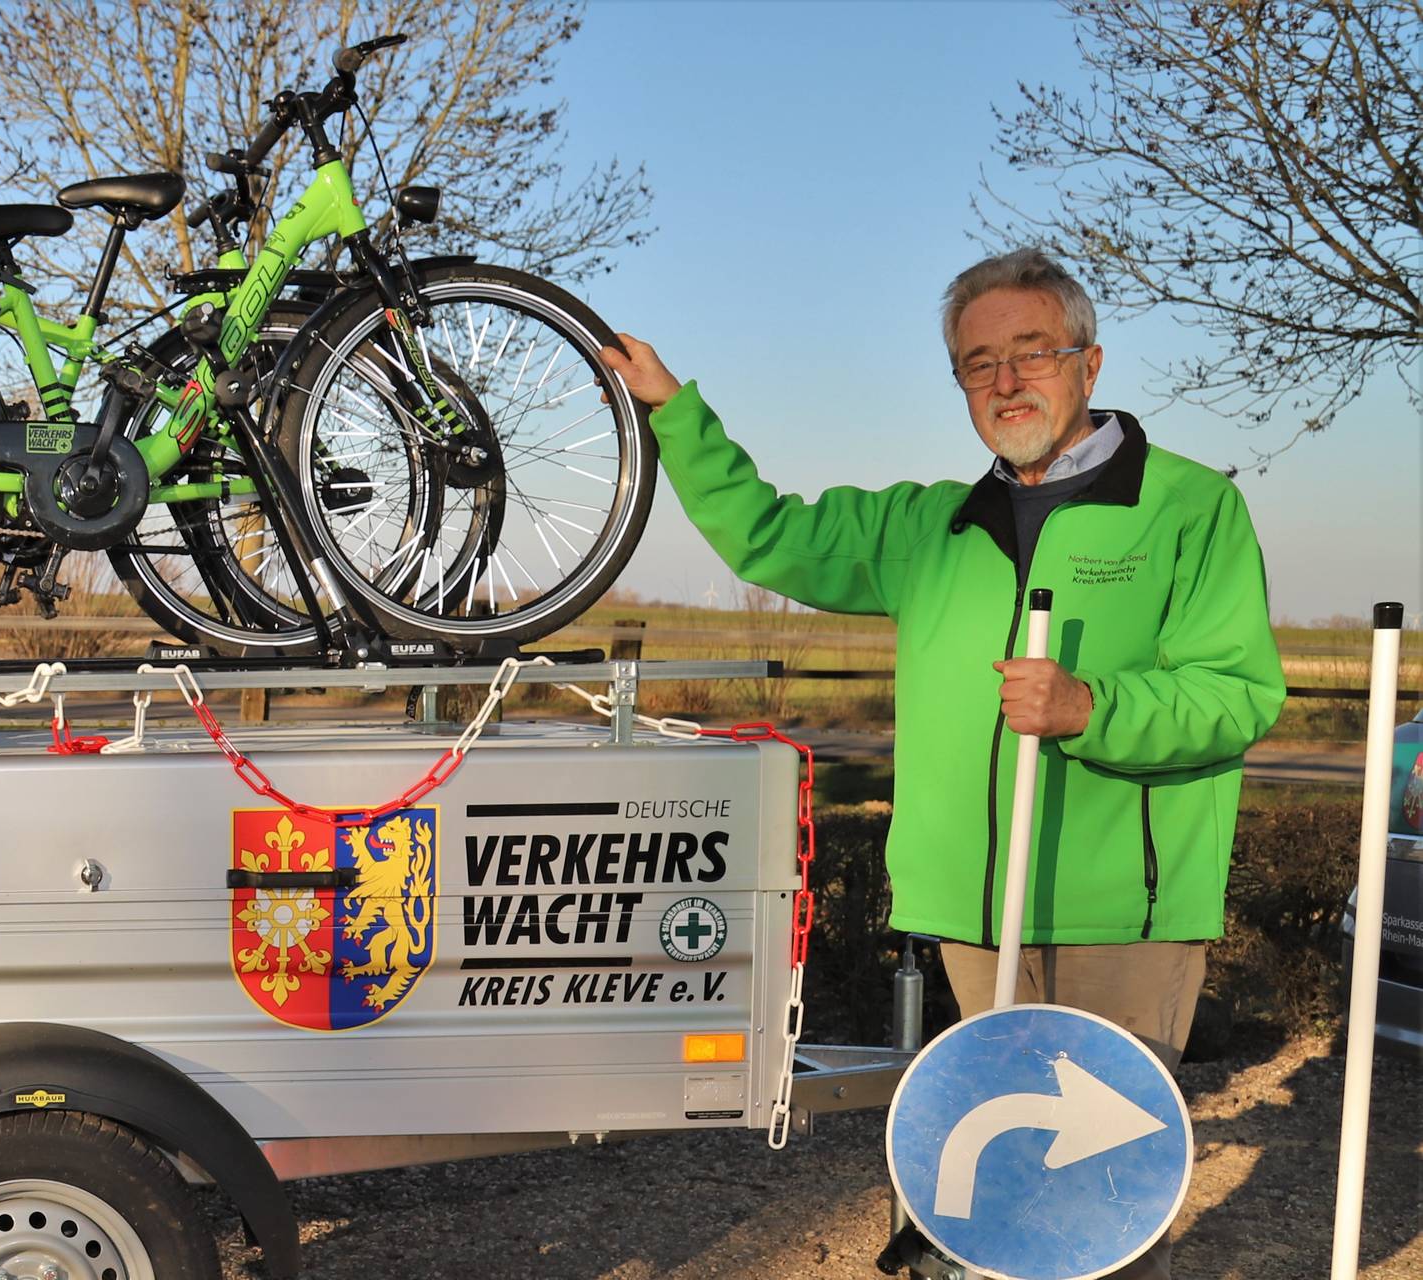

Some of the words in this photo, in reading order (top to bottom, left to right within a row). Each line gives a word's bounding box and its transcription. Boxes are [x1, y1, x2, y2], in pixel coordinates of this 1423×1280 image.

[28, 429, 74, 439] VERKEHRS
[28, 438, 59, 448] WACHT
[1072, 576, 1094, 585] Kreis
[1075, 565, 1136, 577] Verkehrswacht
[160, 649, 201, 659] EUFAB
[391, 644, 435, 655] EUFAB
[624, 799, 732, 819] DEUTSCHE
[465, 831, 729, 886] VERKEHRS
[462, 892, 644, 946] WACHT
[661, 898, 693, 933] SICHERHEIT
[693, 898, 705, 909] IM
[704, 901, 726, 932] VERKEHR
[1382, 911, 1423, 932] Sparkasse
[664, 942, 721, 962] VERKEHRSWACHT
[458, 975, 554, 1006] KREIS
[562, 973, 665, 1004] KLEVE
